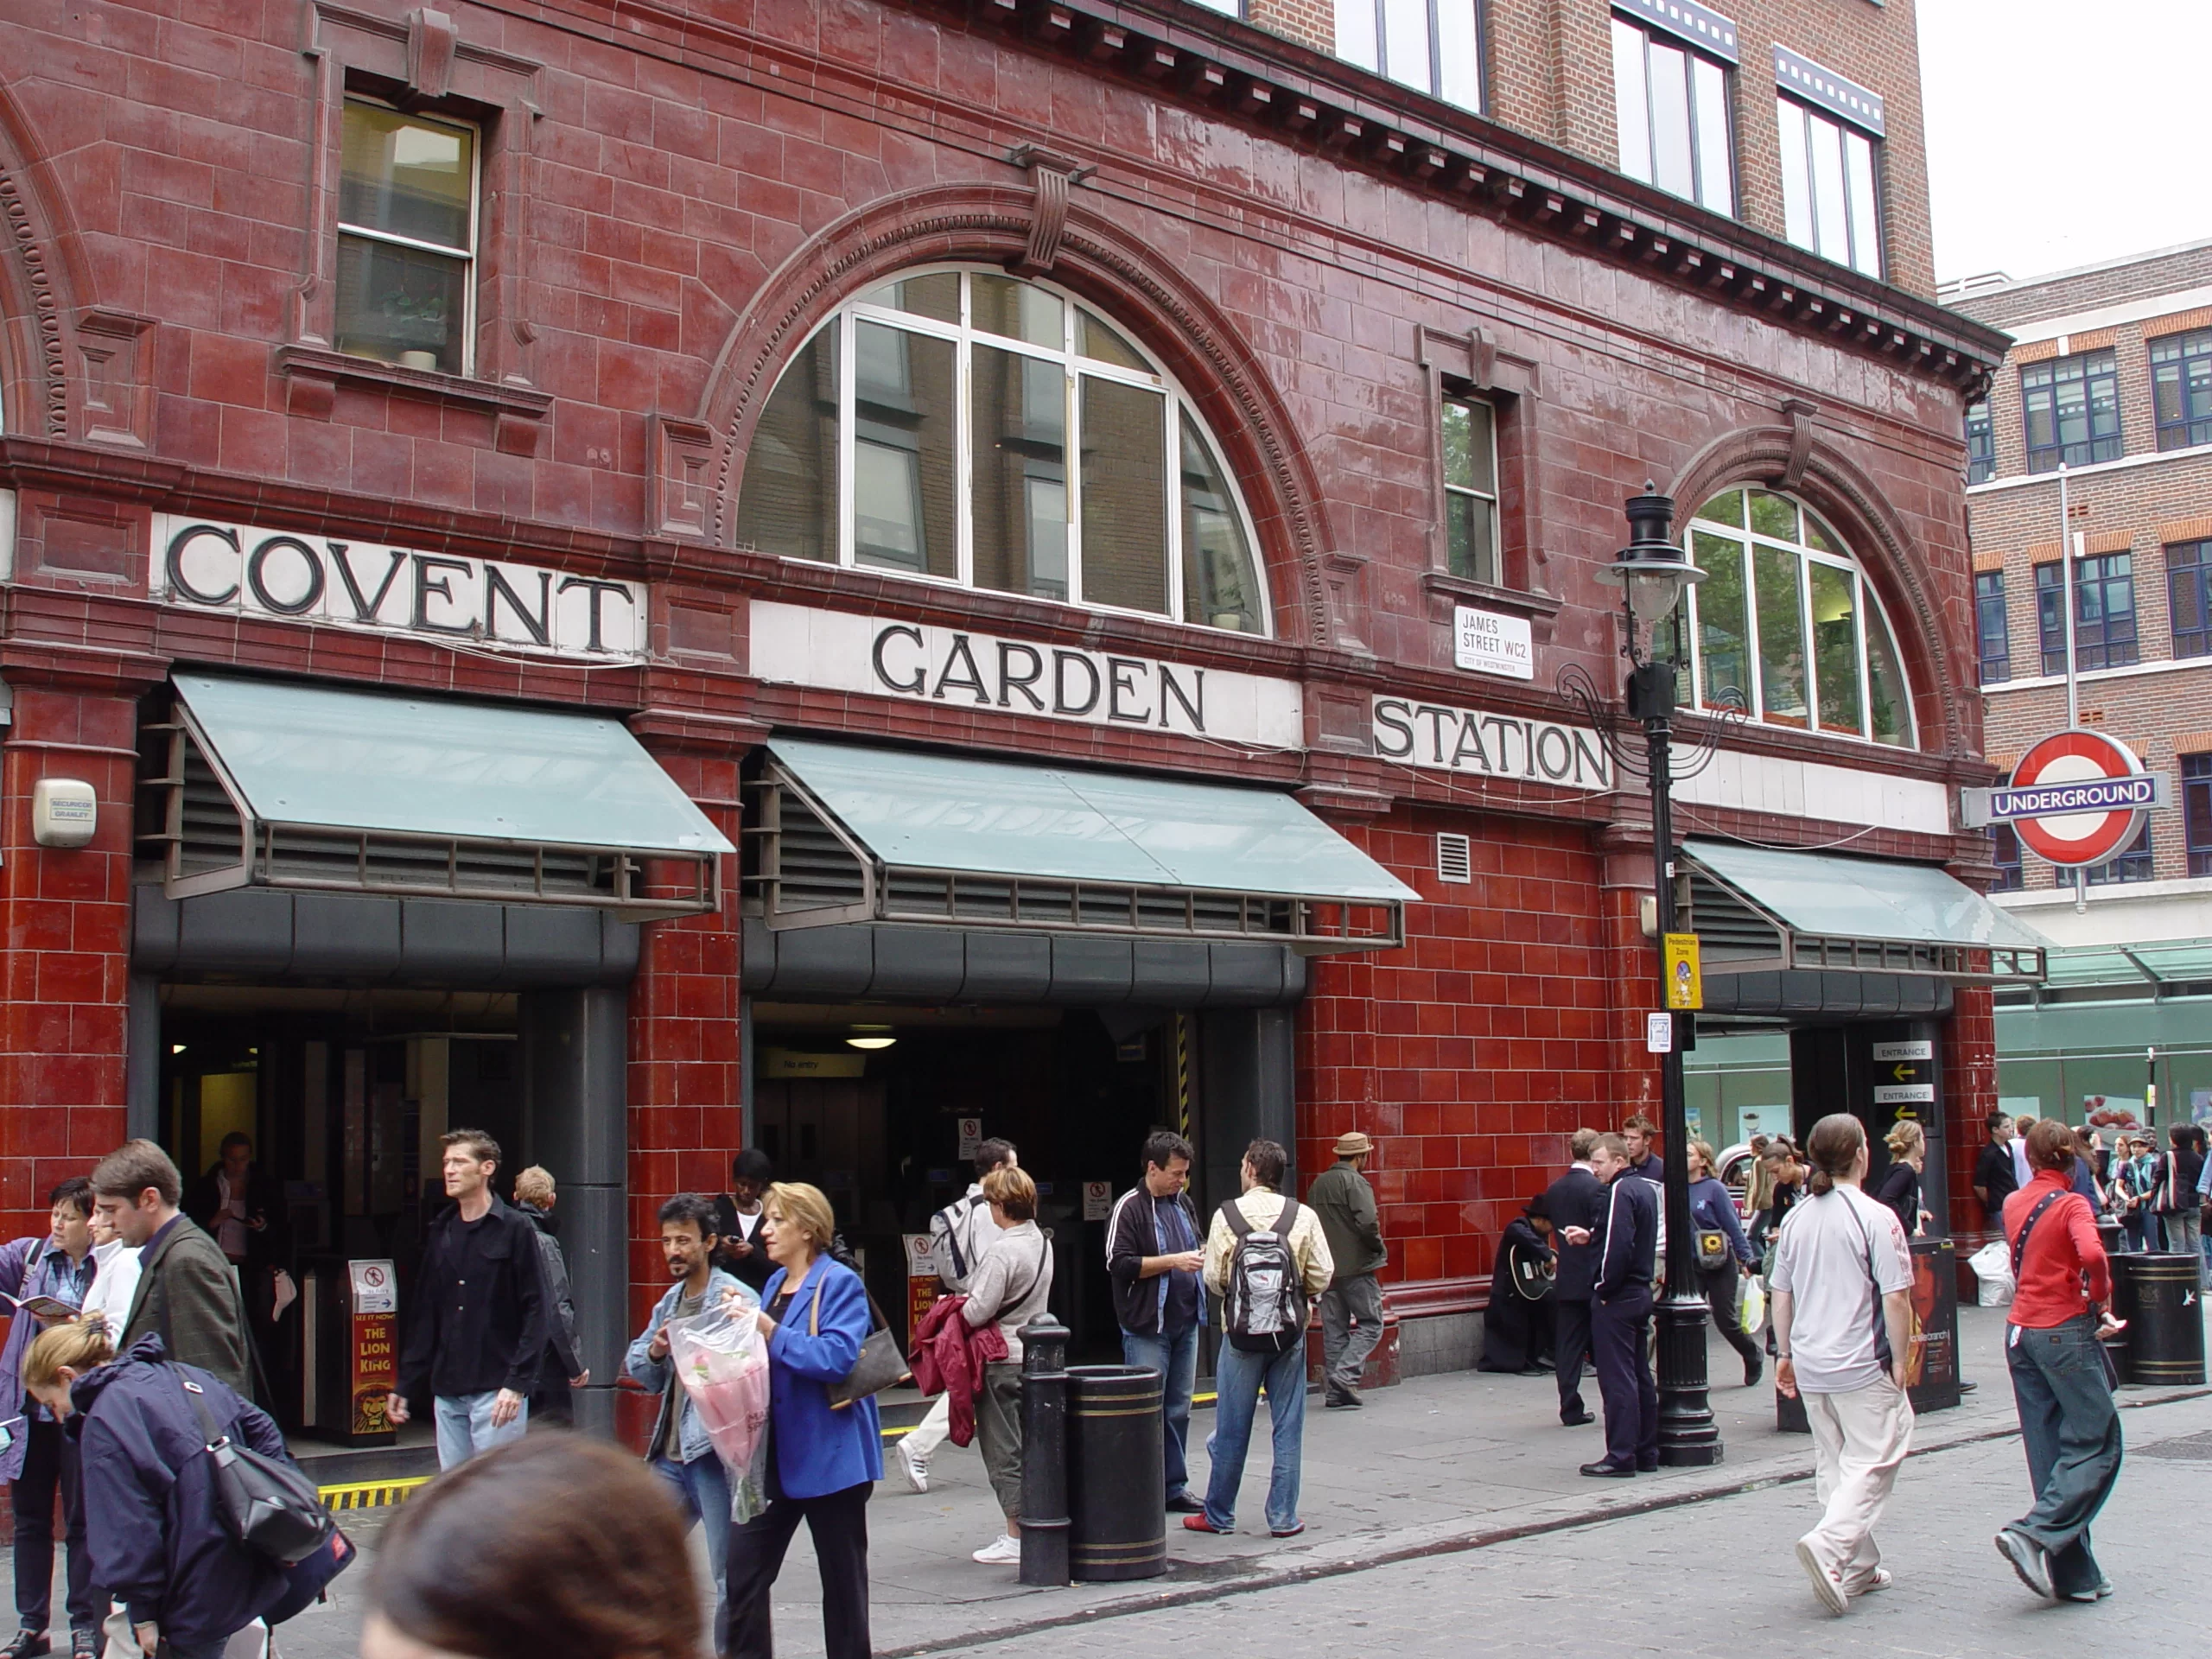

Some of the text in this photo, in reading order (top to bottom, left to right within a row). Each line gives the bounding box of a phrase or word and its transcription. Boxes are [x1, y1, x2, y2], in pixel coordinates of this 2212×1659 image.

[1463, 613, 1497, 634] JAMES
[1464, 632, 1526, 658] STREET WC2
[167, 524, 1610, 786] COVENT GARDEN STATION
[1483, 660, 1516, 672] WESTMINSTER
[1994, 781, 2151, 815] UNDERGROUND
[1675, 947, 1689, 956] Zone
[1881, 1048, 1926, 1057] ENTRANCE
[784, 1060, 819, 1071] No entry
[1883, 1092, 1928, 1101] ENTRANCE
[917, 1288, 931, 1298] THE
[364, 1327, 386, 1339] THE
[359, 1342, 391, 1356] LION
[359, 1358, 391, 1373] KING
